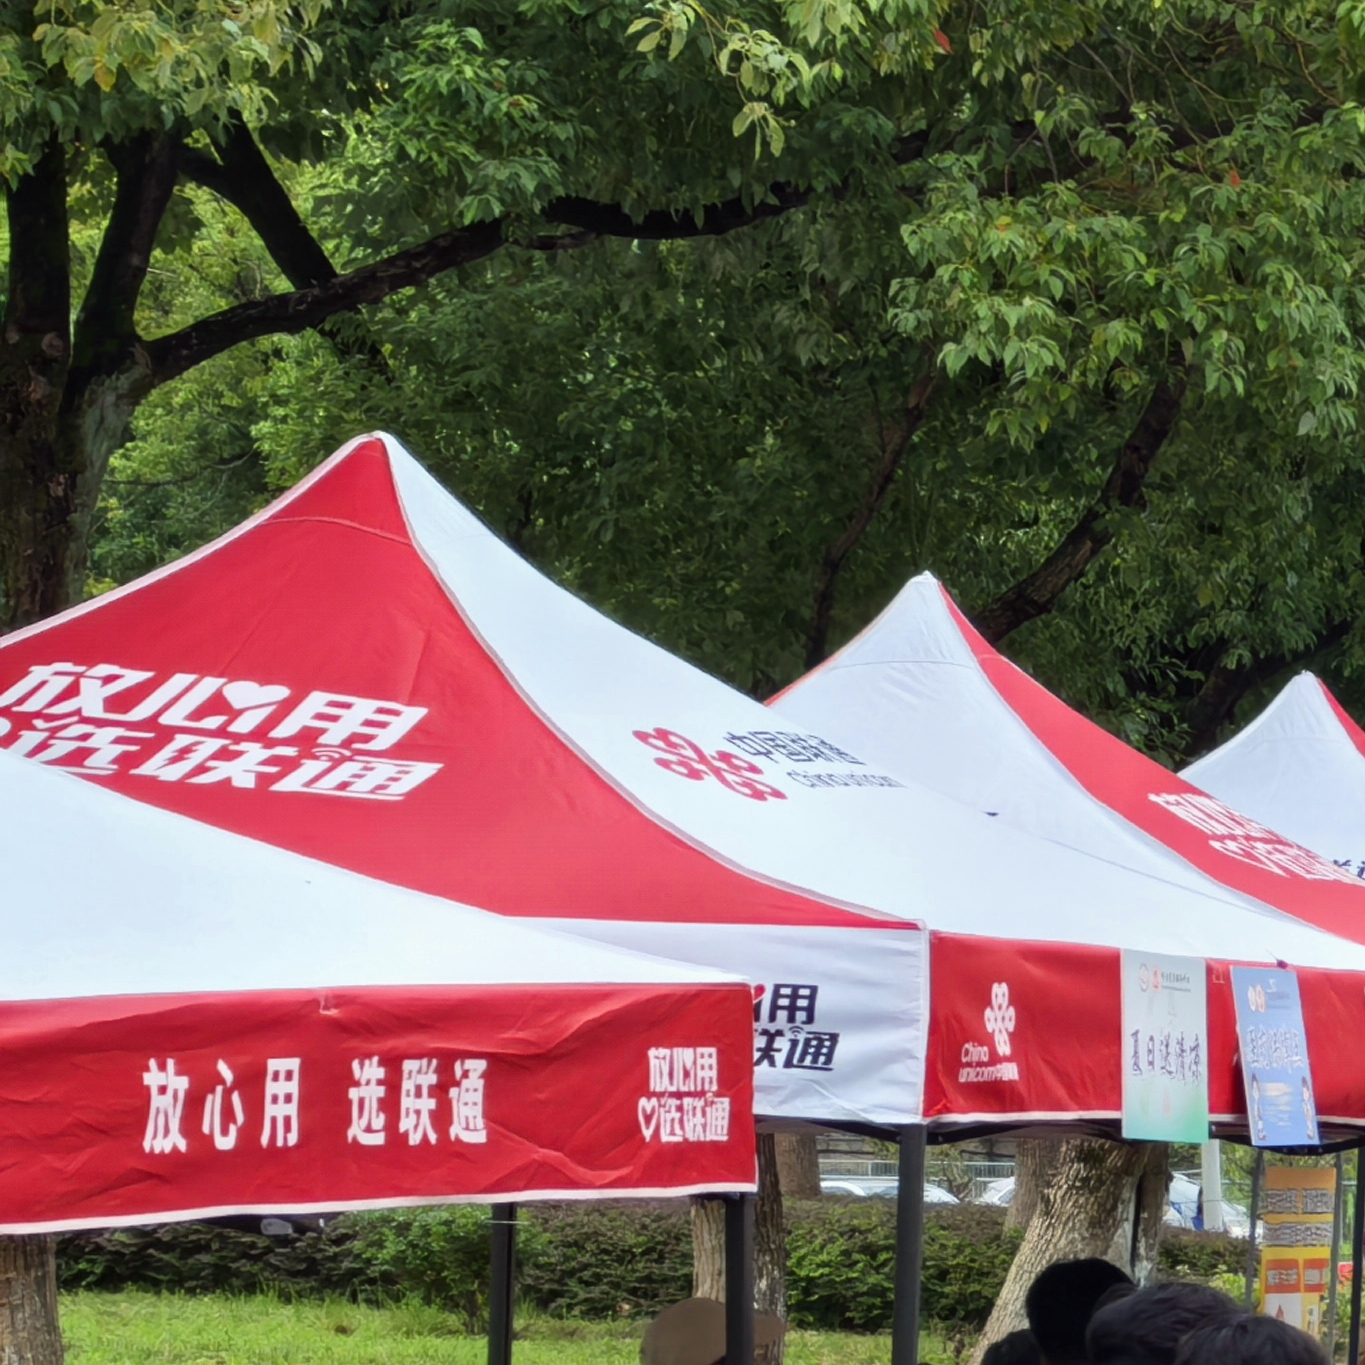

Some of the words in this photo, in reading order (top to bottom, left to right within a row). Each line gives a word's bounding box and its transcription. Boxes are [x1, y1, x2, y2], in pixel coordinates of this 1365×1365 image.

[0, 662, 429, 751] 放心用
[648, 1046, 718, 1092] 放心用
[142, 1055, 302, 1155] 放心用
[346, 1056, 490, 1147] 选联通
[658, 1091, 731, 1143] 选联通
